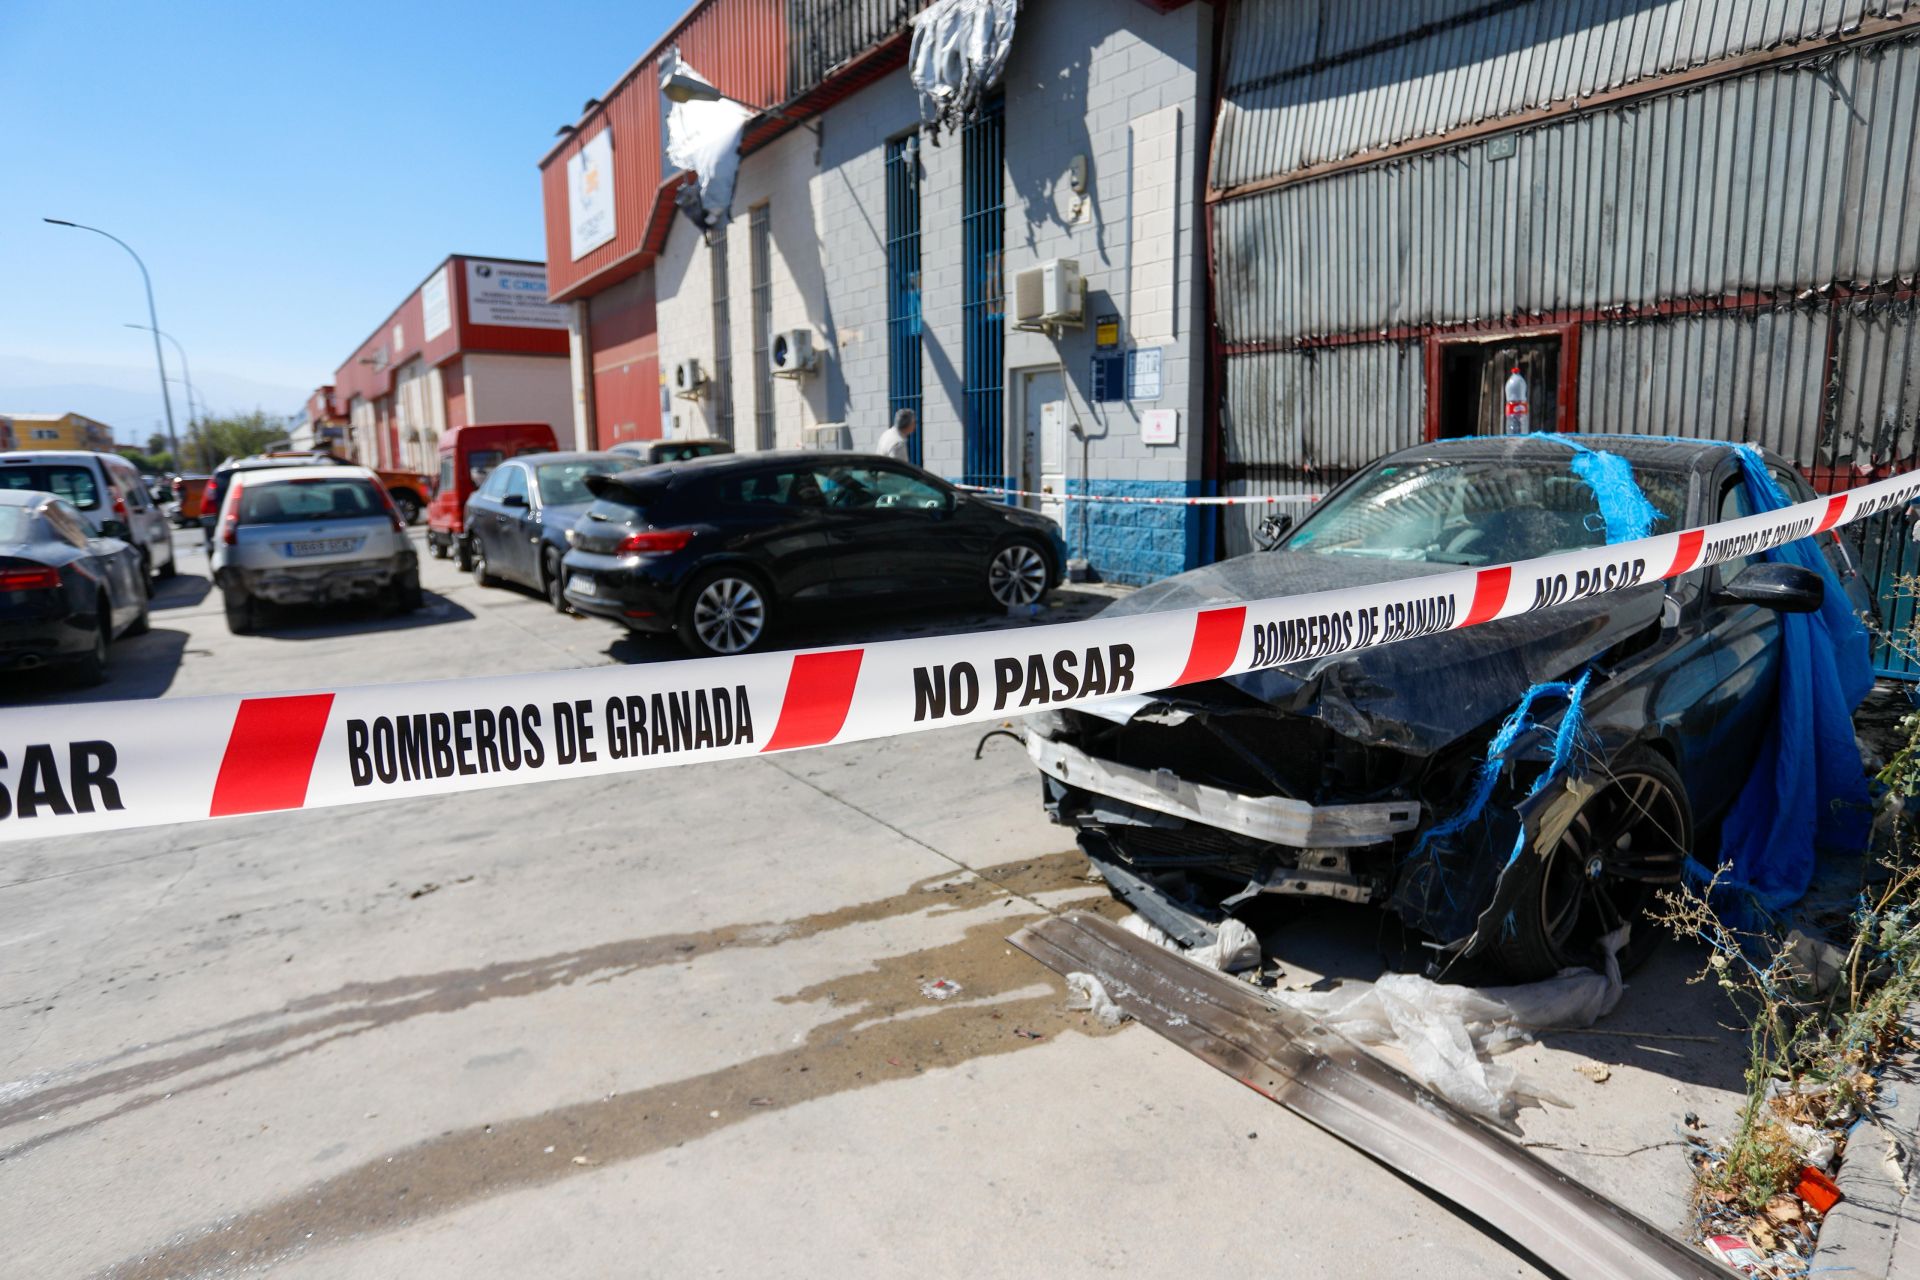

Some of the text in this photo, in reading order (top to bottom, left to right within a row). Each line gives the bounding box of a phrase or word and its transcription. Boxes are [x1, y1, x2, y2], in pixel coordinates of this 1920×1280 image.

[1492, 138, 1509, 155] 25
[1853, 498, 1876, 520] NO
[1701, 516, 1814, 567] BOMBEROS DE GRANADA
[1527, 558, 1646, 612] NO PASAR
[1248, 594, 1456, 669] BOMBEROS DE GRANADA
[913, 643, 1135, 722] NO PASAR
[347, 684, 755, 787] BOMBEROS DE GRANADA
